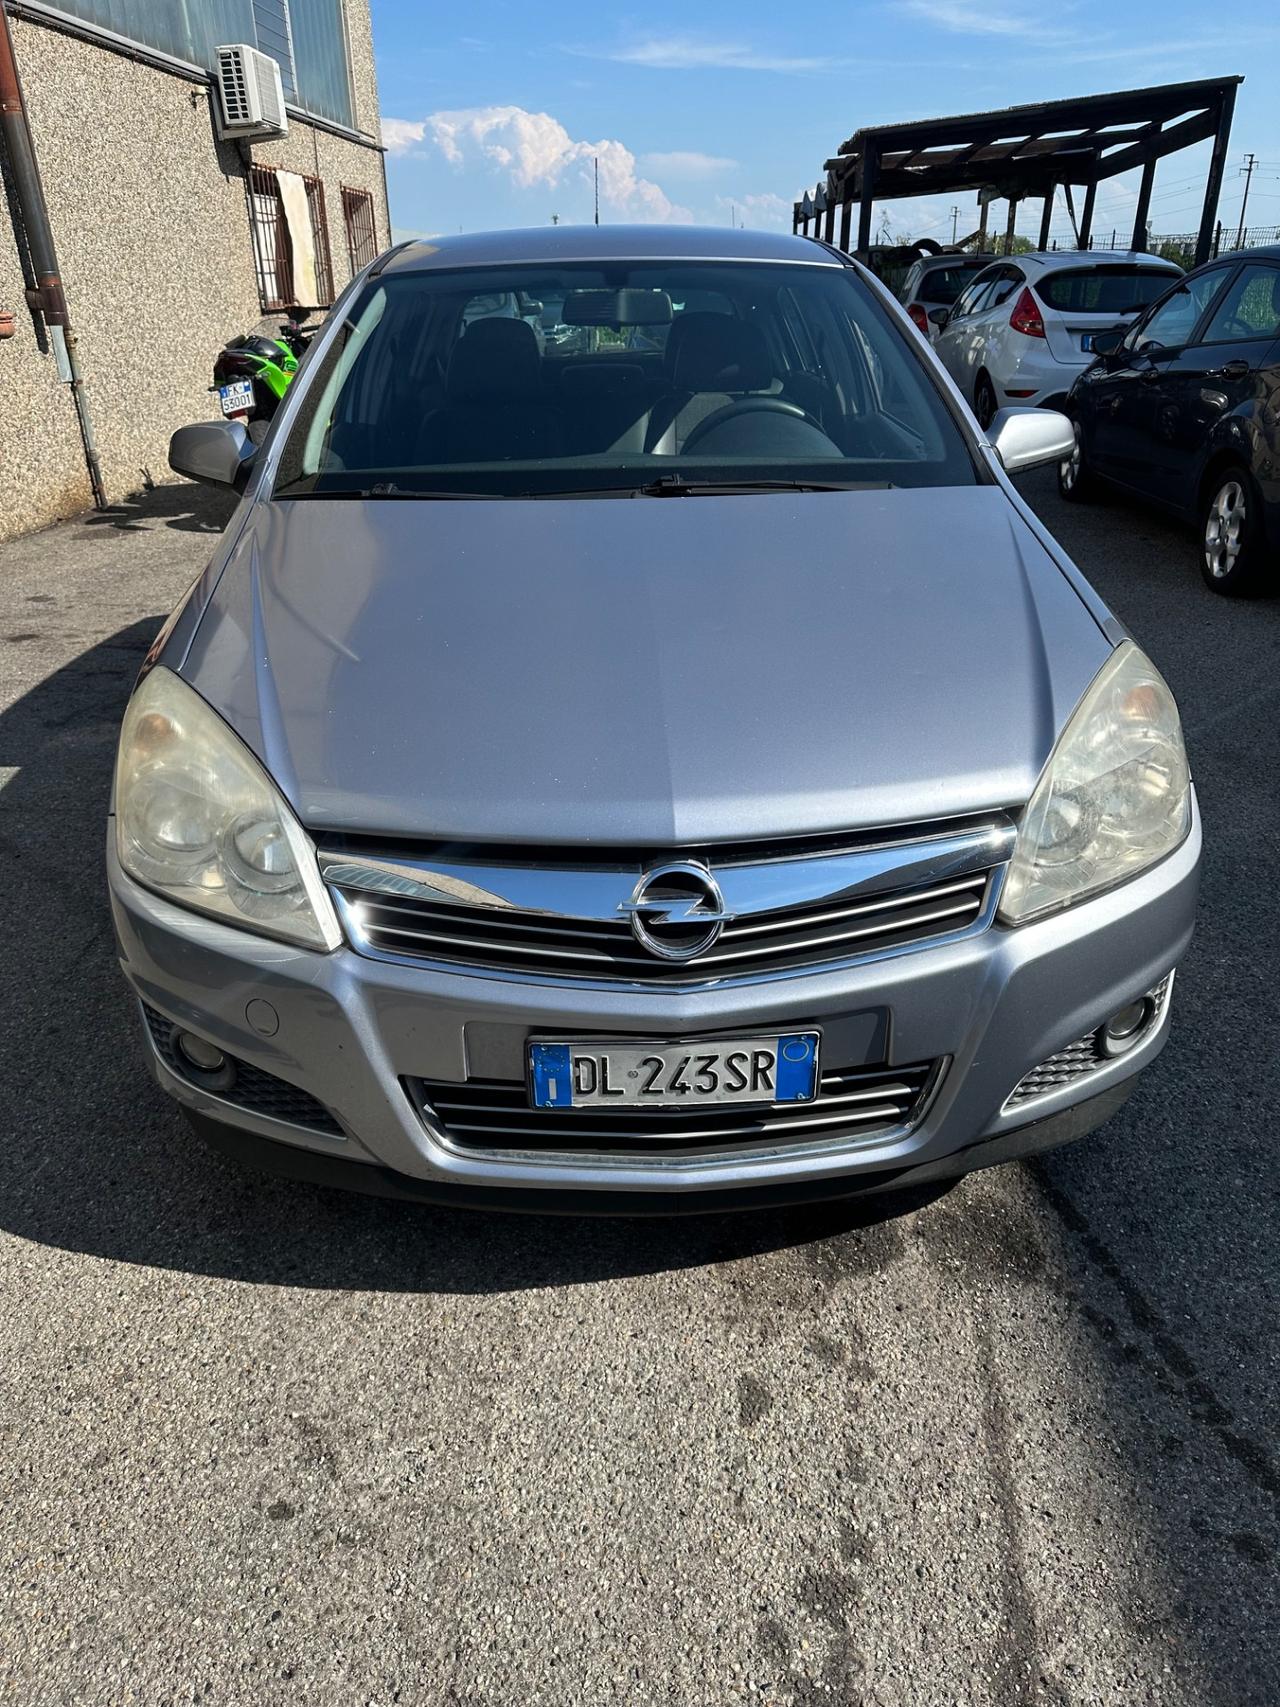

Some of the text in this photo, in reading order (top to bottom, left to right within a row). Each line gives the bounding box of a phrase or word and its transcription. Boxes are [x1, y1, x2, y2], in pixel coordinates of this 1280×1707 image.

[227, 385, 239, 396] FK
[223, 394, 251, 411] 53001
[574, 1050, 775, 1095] DL 243SR
